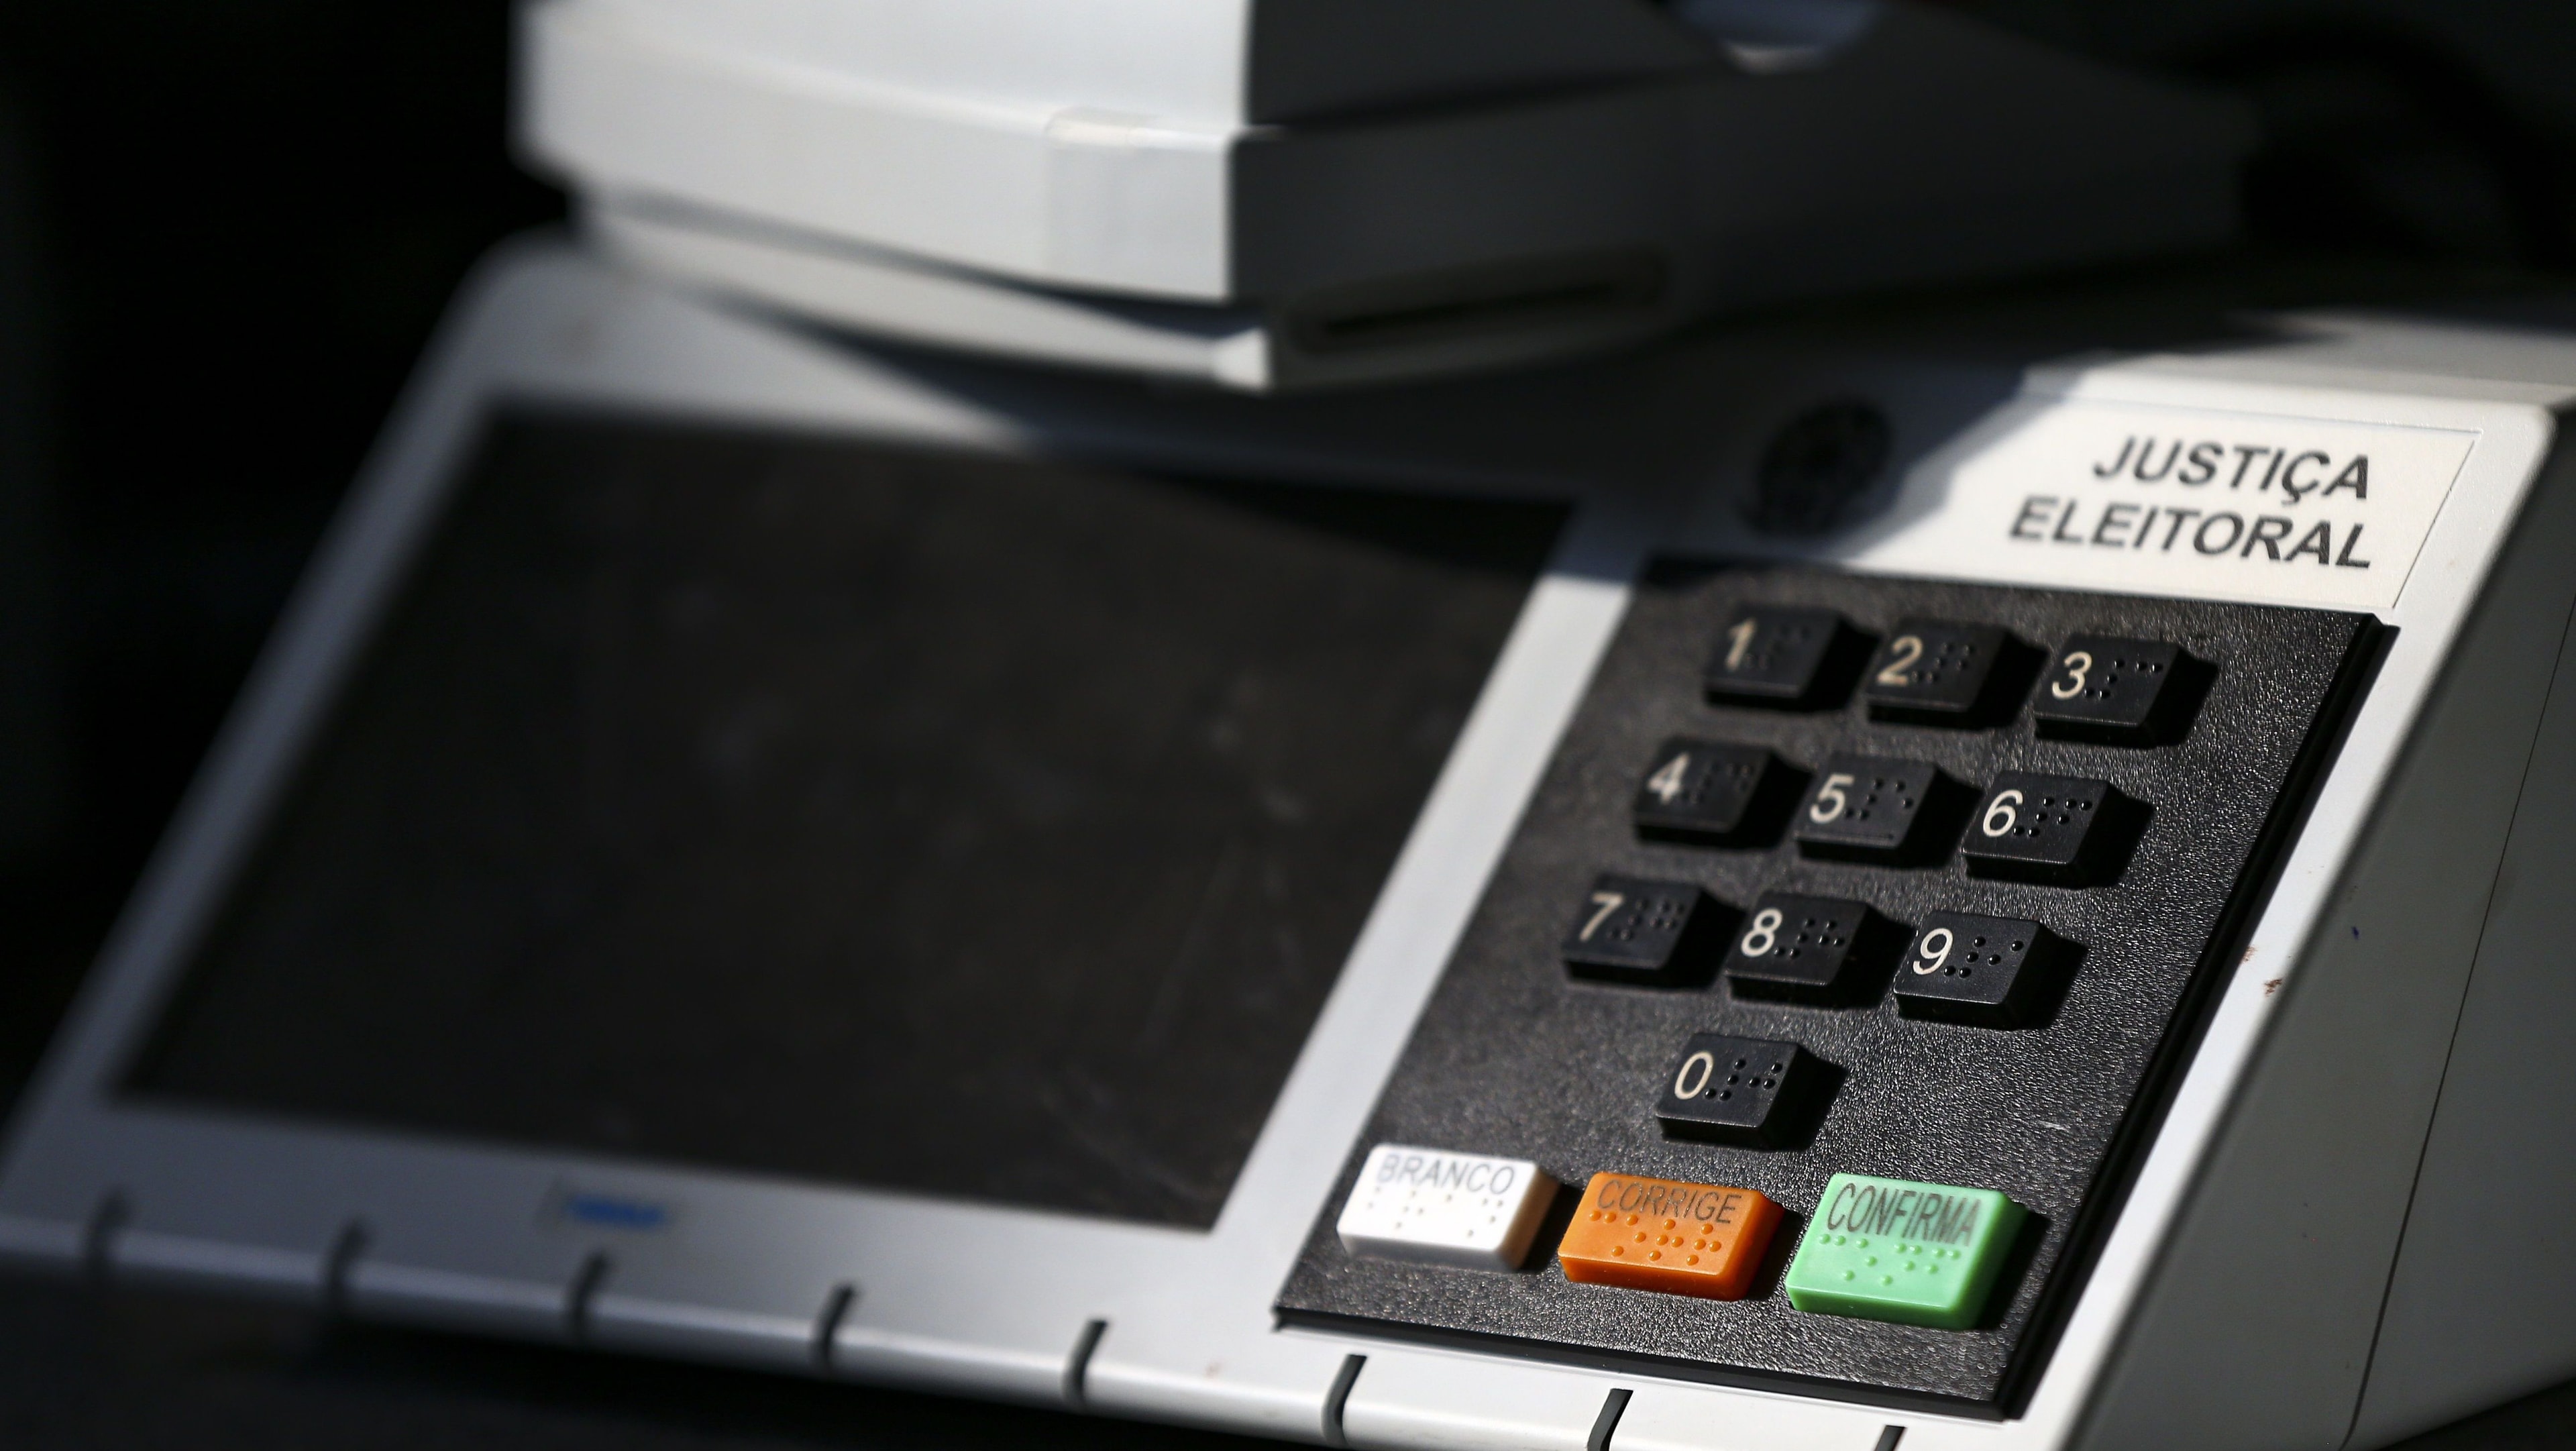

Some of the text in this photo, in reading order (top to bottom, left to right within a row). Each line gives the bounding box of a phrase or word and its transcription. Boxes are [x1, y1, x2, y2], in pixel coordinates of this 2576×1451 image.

[2094, 435, 2369, 506] JUSTIÇA
[2011, 495, 2371, 569] ELEITORAL
[1725, 620, 1756, 667] 1
[1877, 636, 1922, 684] 2
[2051, 651, 2091, 699] 3
[1648, 753, 1690, 800] 4
[1810, 774, 1854, 822] 5
[1982, 789, 2023, 837] 6
[1578, 893, 1621, 939] 7
[1741, 908, 1782, 957] 8
[1913, 928, 1953, 977] 9
[1674, 1051, 1713, 1099] 0
[1378, 1152, 1516, 1195] BRANCO
[1597, 1179, 1742, 1226] CORRIGE
[1826, 1183, 1983, 1246] CONFIRMA
